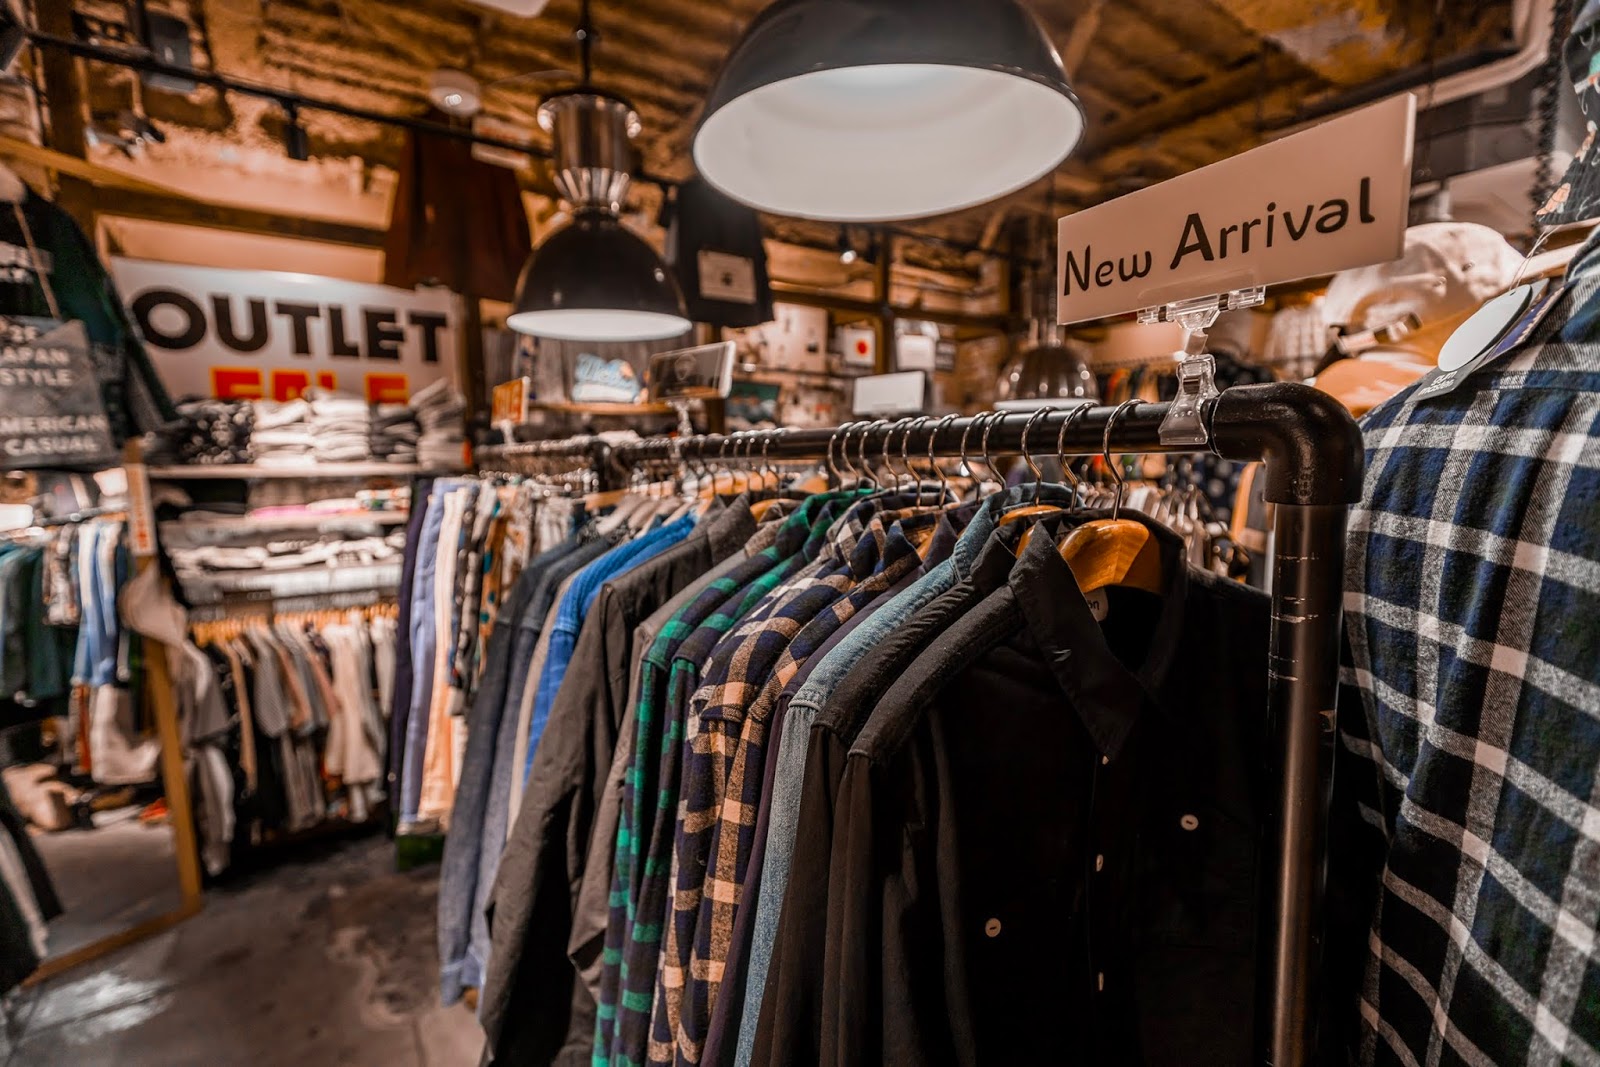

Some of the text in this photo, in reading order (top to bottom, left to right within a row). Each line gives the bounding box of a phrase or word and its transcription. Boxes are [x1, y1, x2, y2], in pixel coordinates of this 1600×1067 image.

[1063, 176, 1376, 296] New Arrival
[131, 289, 447, 362] OUTLET
[0, 346, 70, 365] APAN
[0, 368, 72, 387] STYLE
[0, 414, 107, 435] MERICAN
[4, 436, 99, 457] CASUAL
